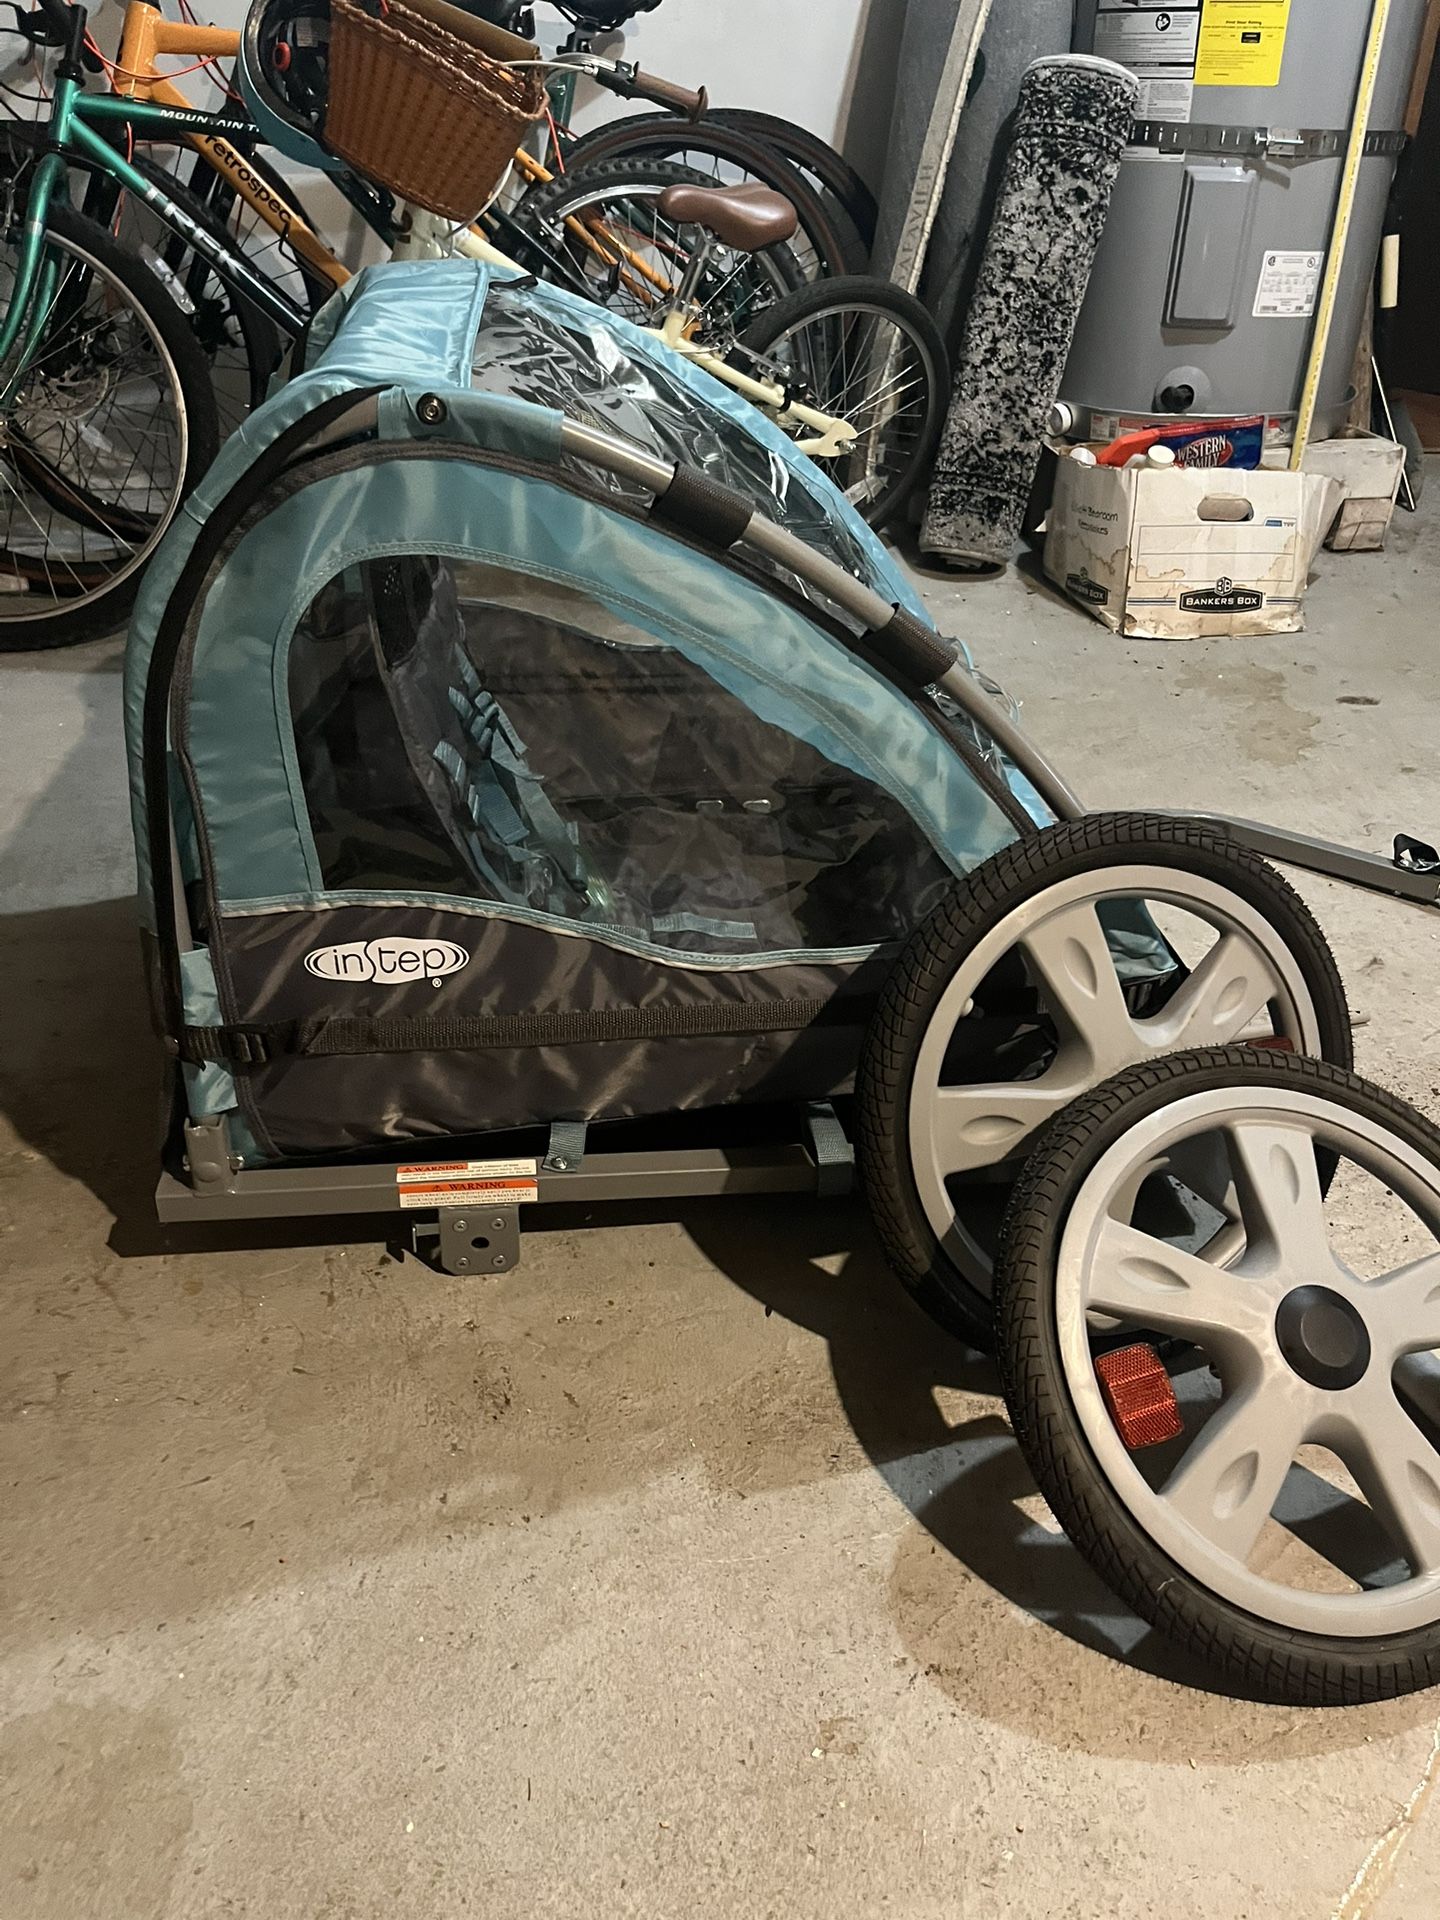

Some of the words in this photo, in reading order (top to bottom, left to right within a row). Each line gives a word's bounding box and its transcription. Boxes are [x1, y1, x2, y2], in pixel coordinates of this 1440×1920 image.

[159, 109, 244, 130] MOUNAIN
[204, 135, 292, 223] retrospec
[143, 178, 241, 280] TREK
[1177, 434, 1226, 460] WESTERN
[1185, 597, 1235, 605] BANKERS
[1237, 596, 1258, 605] BOX
[414, 1164, 464, 1172] WARNING
[448, 1181, 506, 1191] WARNING
